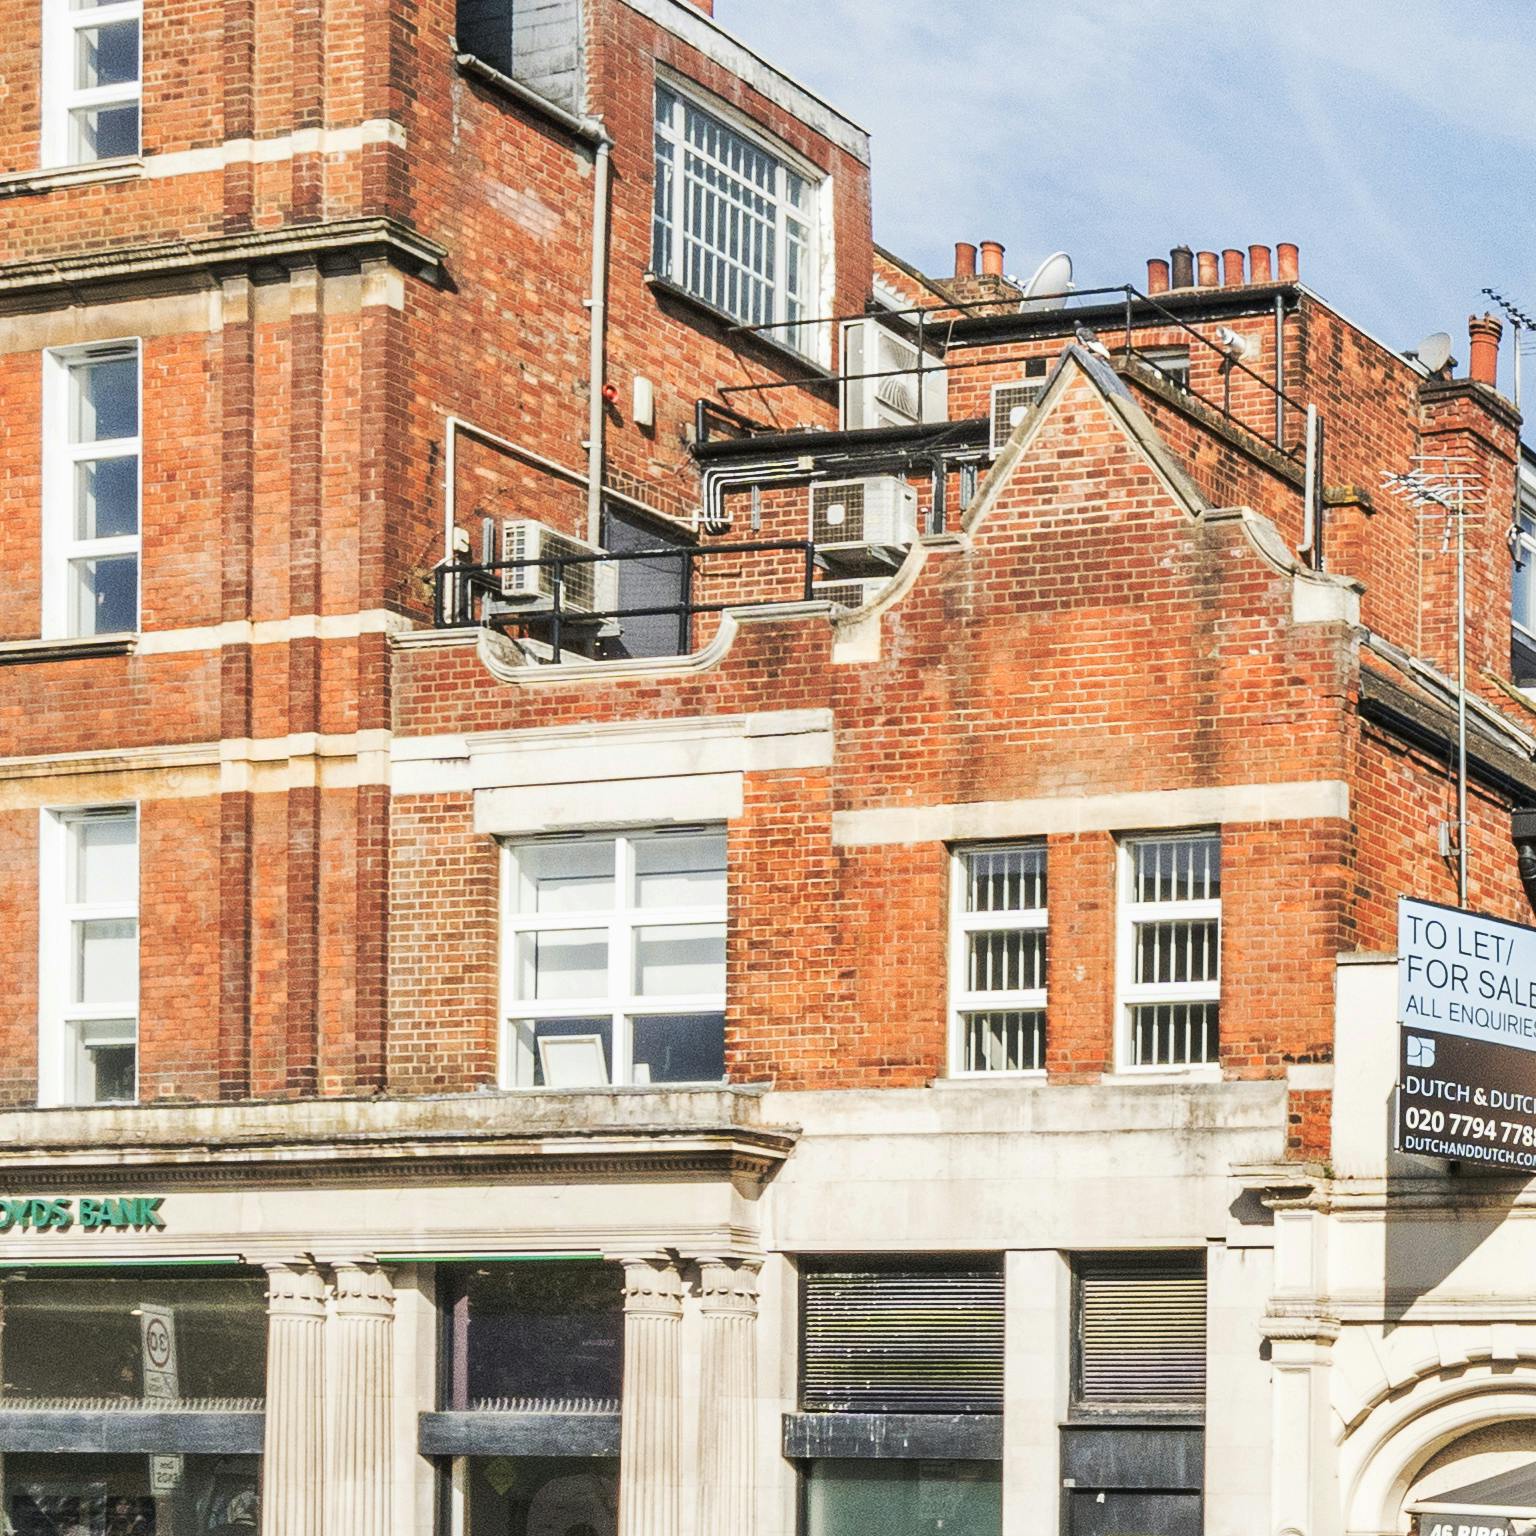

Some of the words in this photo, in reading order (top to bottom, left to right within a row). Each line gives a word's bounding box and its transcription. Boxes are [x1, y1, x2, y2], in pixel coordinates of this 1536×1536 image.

[1407, 915, 1447, 949] TO
[1458, 926, 1514, 966] LET/
[1408, 955, 1468, 994] FOR
[1406, 995, 1442, 1018] ALL
[1406, 1075, 1469, 1103] DUTCH
[1473, 1087, 1488, 1106] &
[1405, 1107, 1444, 1132] 020
[1449, 1113, 1497, 1141] 7794
[80, 1197, 166, 1231] BANK
